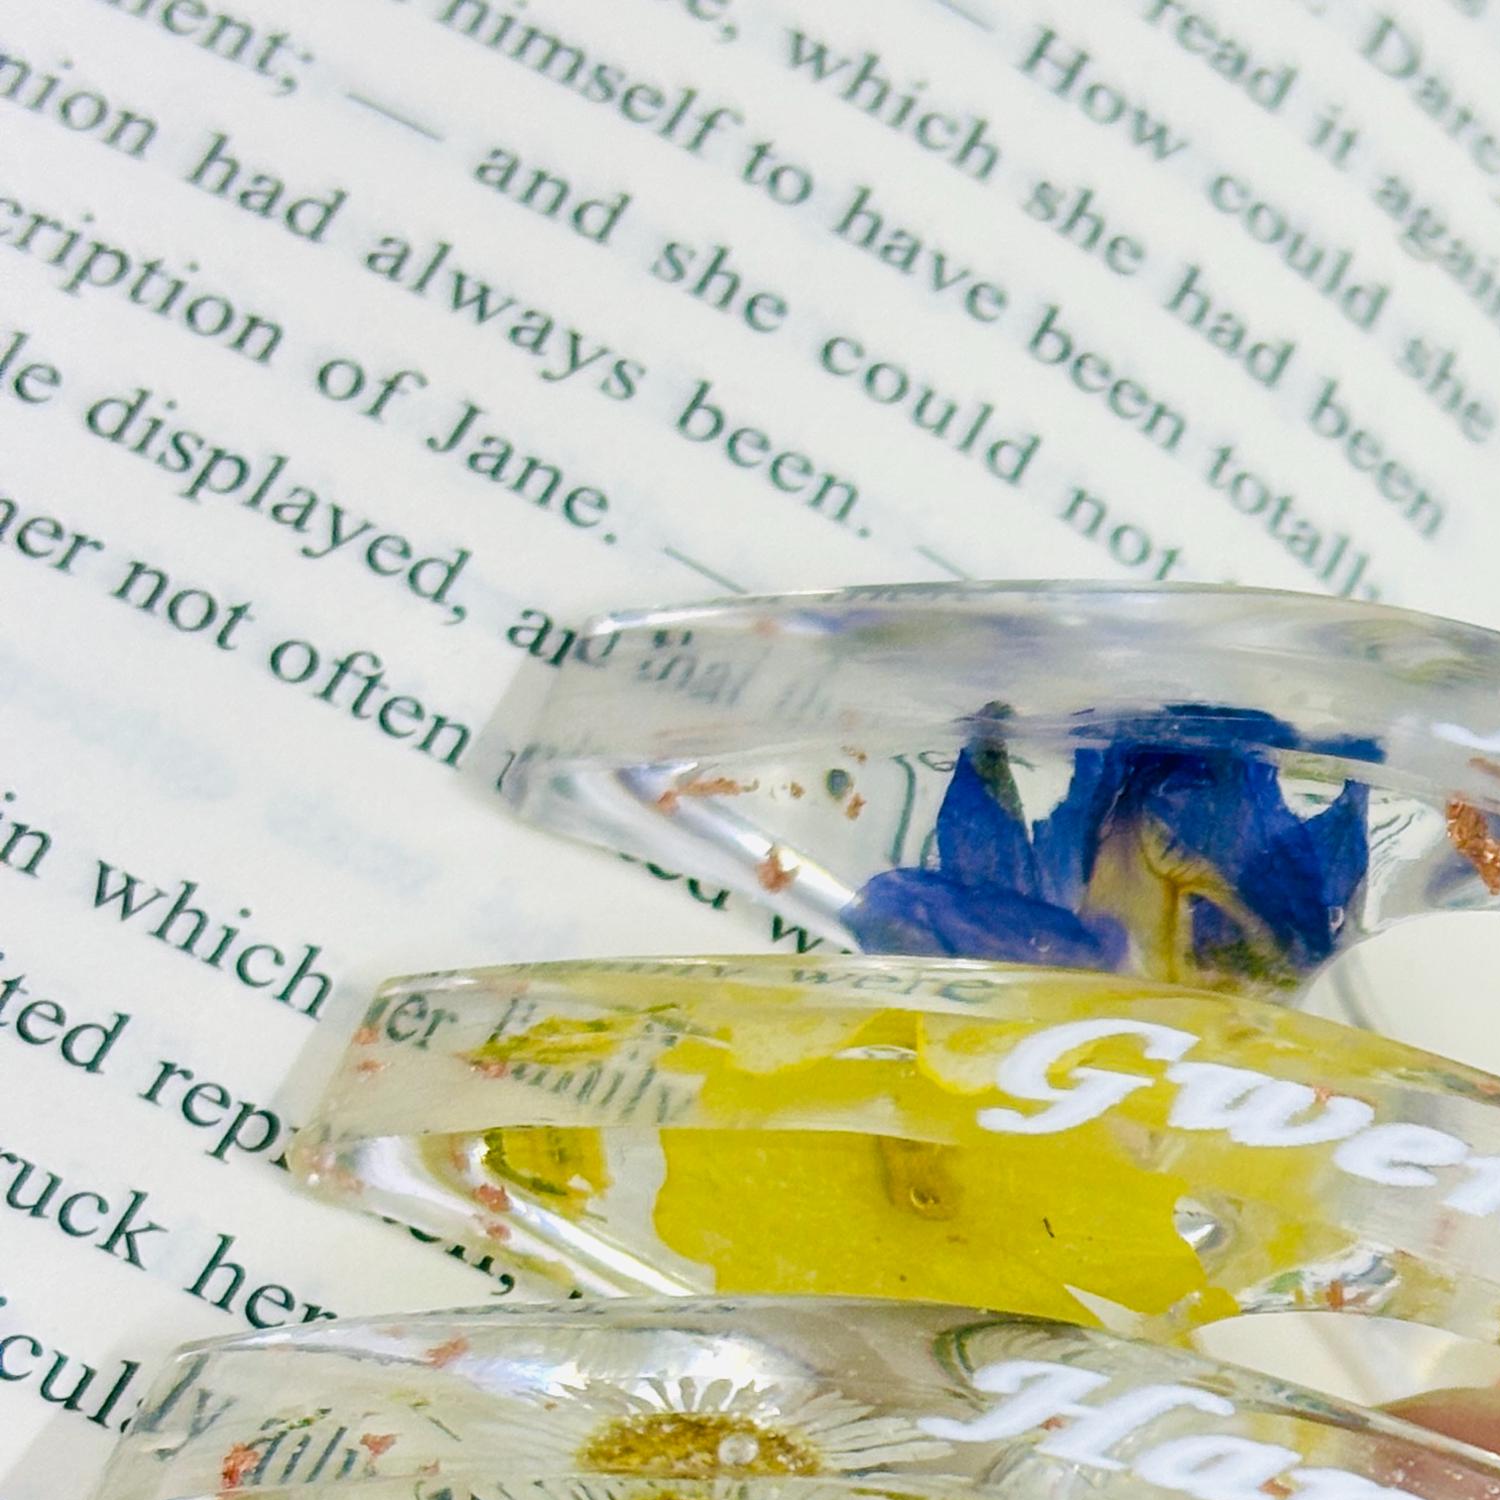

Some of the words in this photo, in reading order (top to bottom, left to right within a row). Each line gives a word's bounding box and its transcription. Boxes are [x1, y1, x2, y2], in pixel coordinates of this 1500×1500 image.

[1014, 25, 1190, 163] How
[1205, 173, 1392, 333] could
[1398, 337, 1497, 445] she
[1306, 104, 1360, 171] it
[183, 131, 350, 245] had
[360, 235, 648, 402] always
[676, 379, 872, 540] been.
[471, 146, 633, 248] and
[649, 239, 790, 335] she
[817, 335, 1043, 487] could
[1058, 484, 1187, 582] not
[741, 139, 816, 208] to
[829, 184, 1009, 325] have
[1026, 303, 1187, 457] been
[784, 26, 1003, 184] which
[1023, 180, 1148, 278] she
[1162, 263, 1297, 393] had
[1306, 377, 1449, 541] been
[82, 387, 473, 626] displayed,
[312, 357, 429, 425] of
[424, 399, 618, 545] Jane.
[110, 560, 258, 653] not
[268, 638, 473, 768] often
[93, 858, 335, 1022] which
